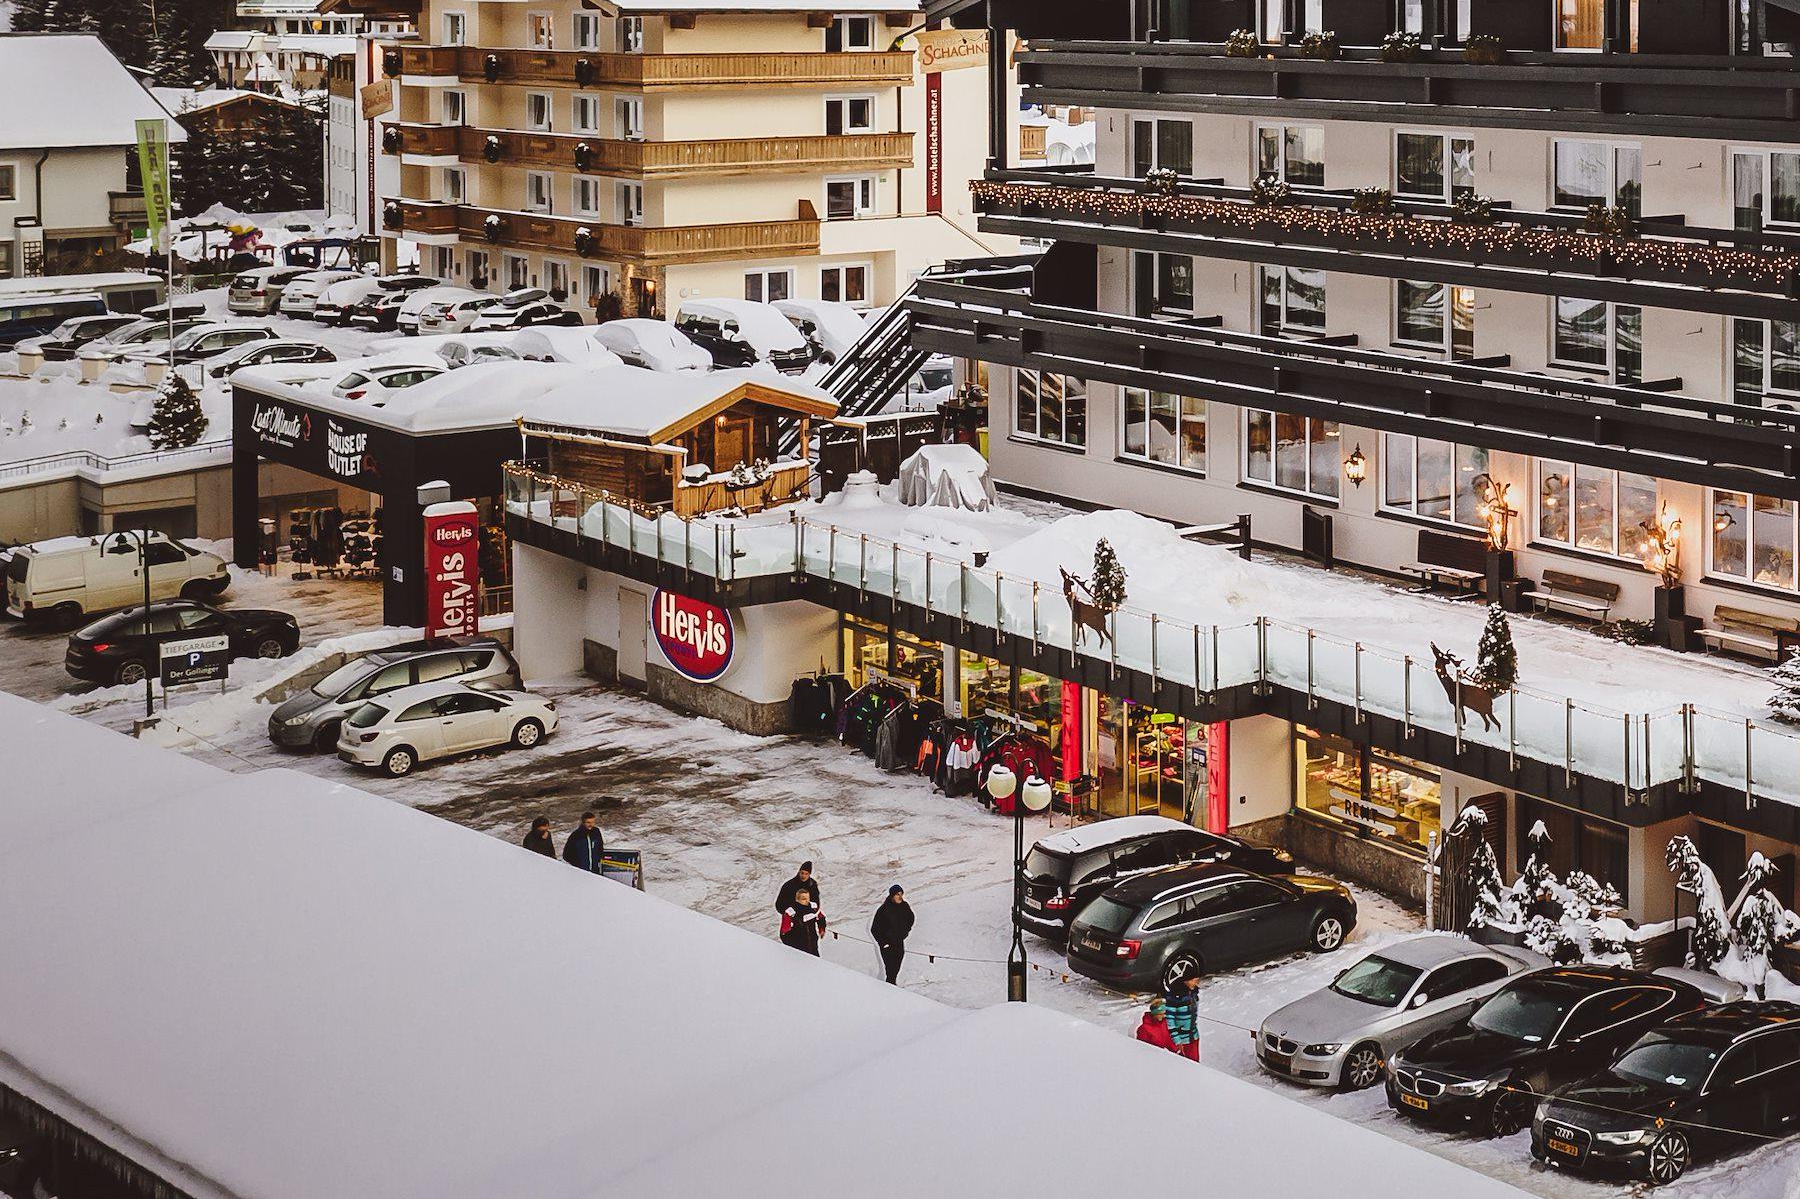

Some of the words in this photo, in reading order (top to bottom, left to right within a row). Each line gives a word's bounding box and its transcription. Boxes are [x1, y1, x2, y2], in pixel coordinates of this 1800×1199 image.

[922, 42, 989, 66] SCHACHNE
[328, 428, 355, 454] HOUSE
[355, 433, 368, 453] OF
[328, 449, 362, 477] OUTLET
[436, 526, 473, 541] Hervis
[660, 591, 727, 659] Hervis
[164, 641, 216, 654] TIEFGARAGE
[189, 653, 201, 666] P
